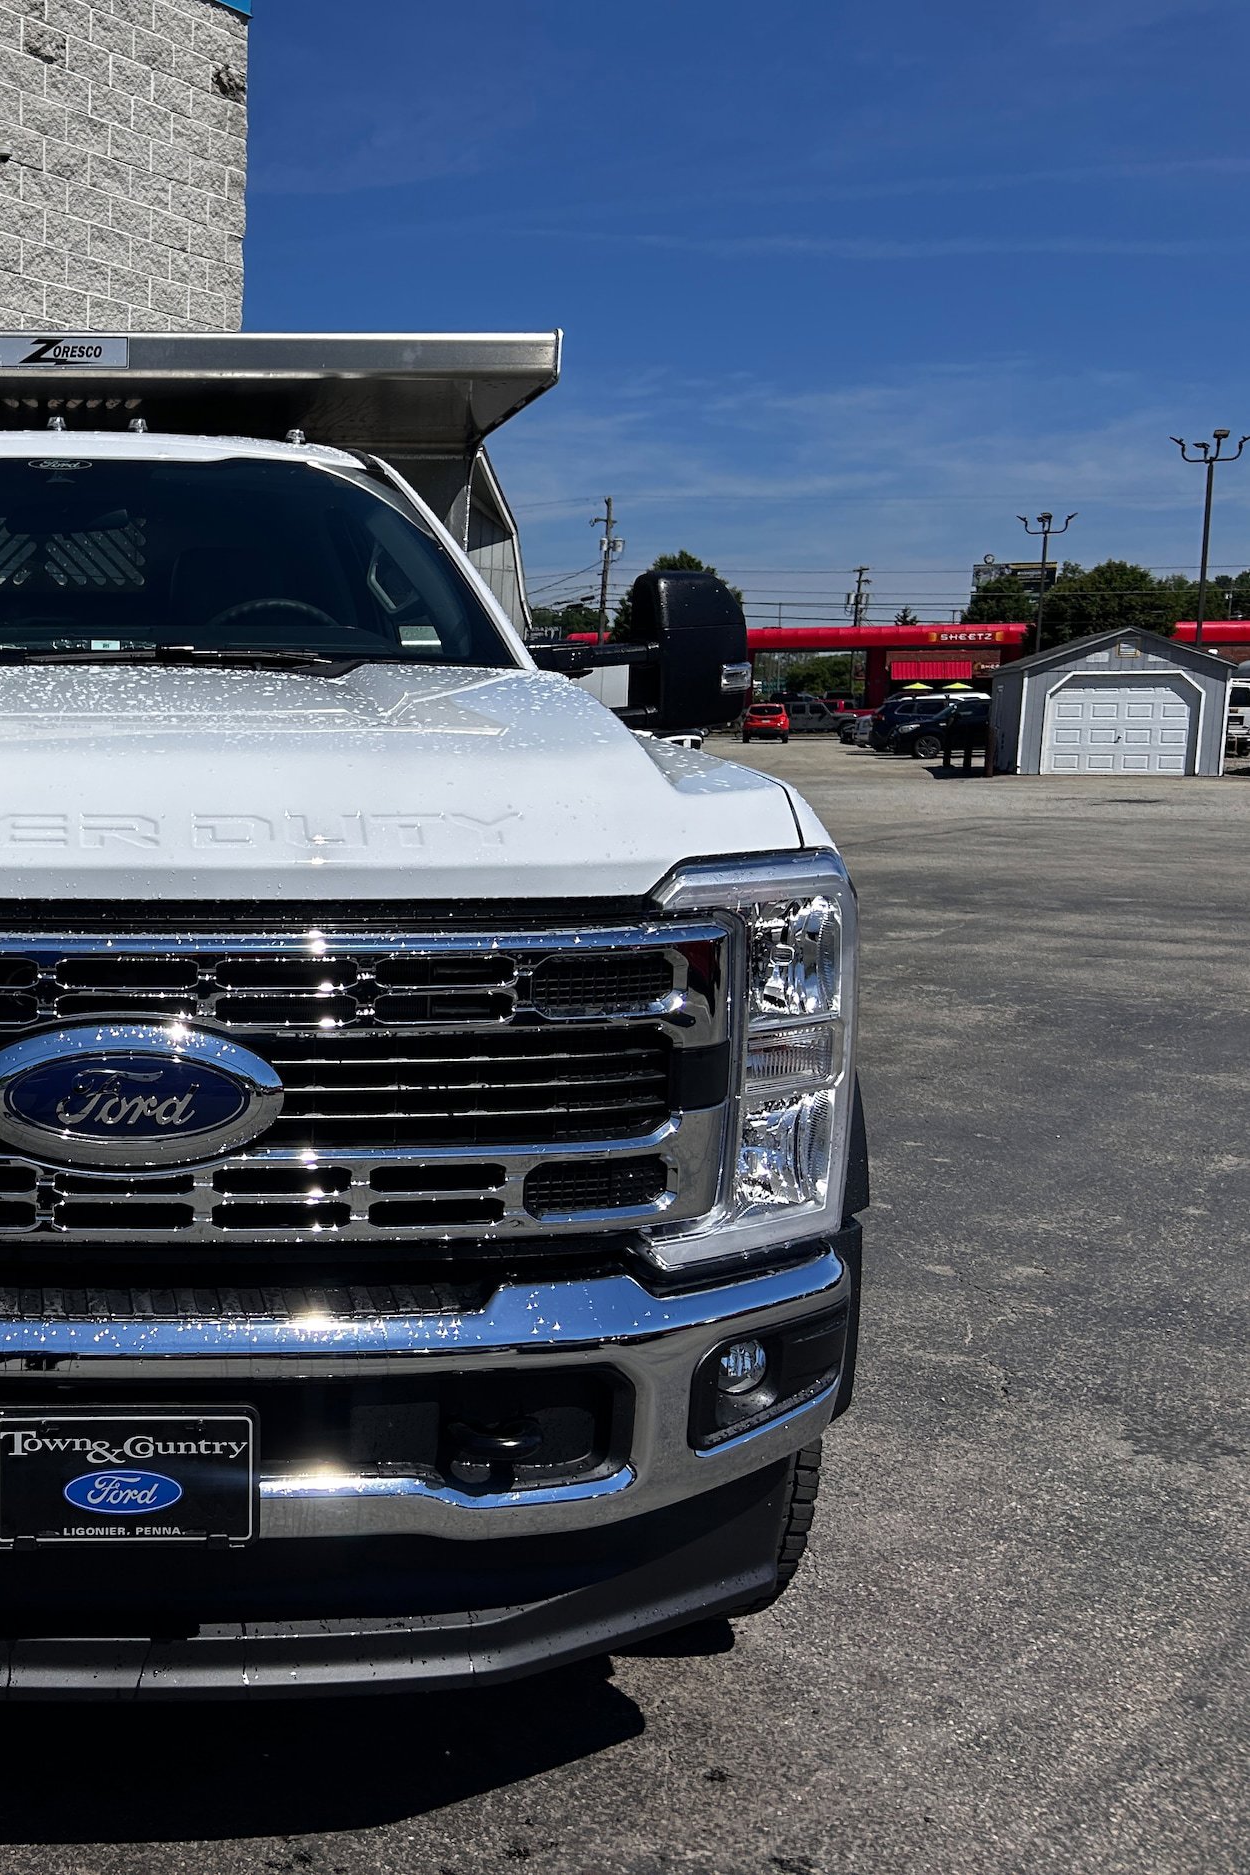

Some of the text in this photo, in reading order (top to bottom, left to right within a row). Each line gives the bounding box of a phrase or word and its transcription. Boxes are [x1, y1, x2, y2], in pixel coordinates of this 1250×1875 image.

[19, 338, 102, 365] ZORESCO
[38, 459, 81, 469] Ford
[940, 632, 993, 641] SHEETZ
[191, 810, 524, 849] DUTY
[56, 1068, 200, 1126] Ford
[0, 1431, 247, 1464] Town & Country
[87, 1475, 159, 1505] Ford
[135, 1527, 186, 1536] PENNA.
